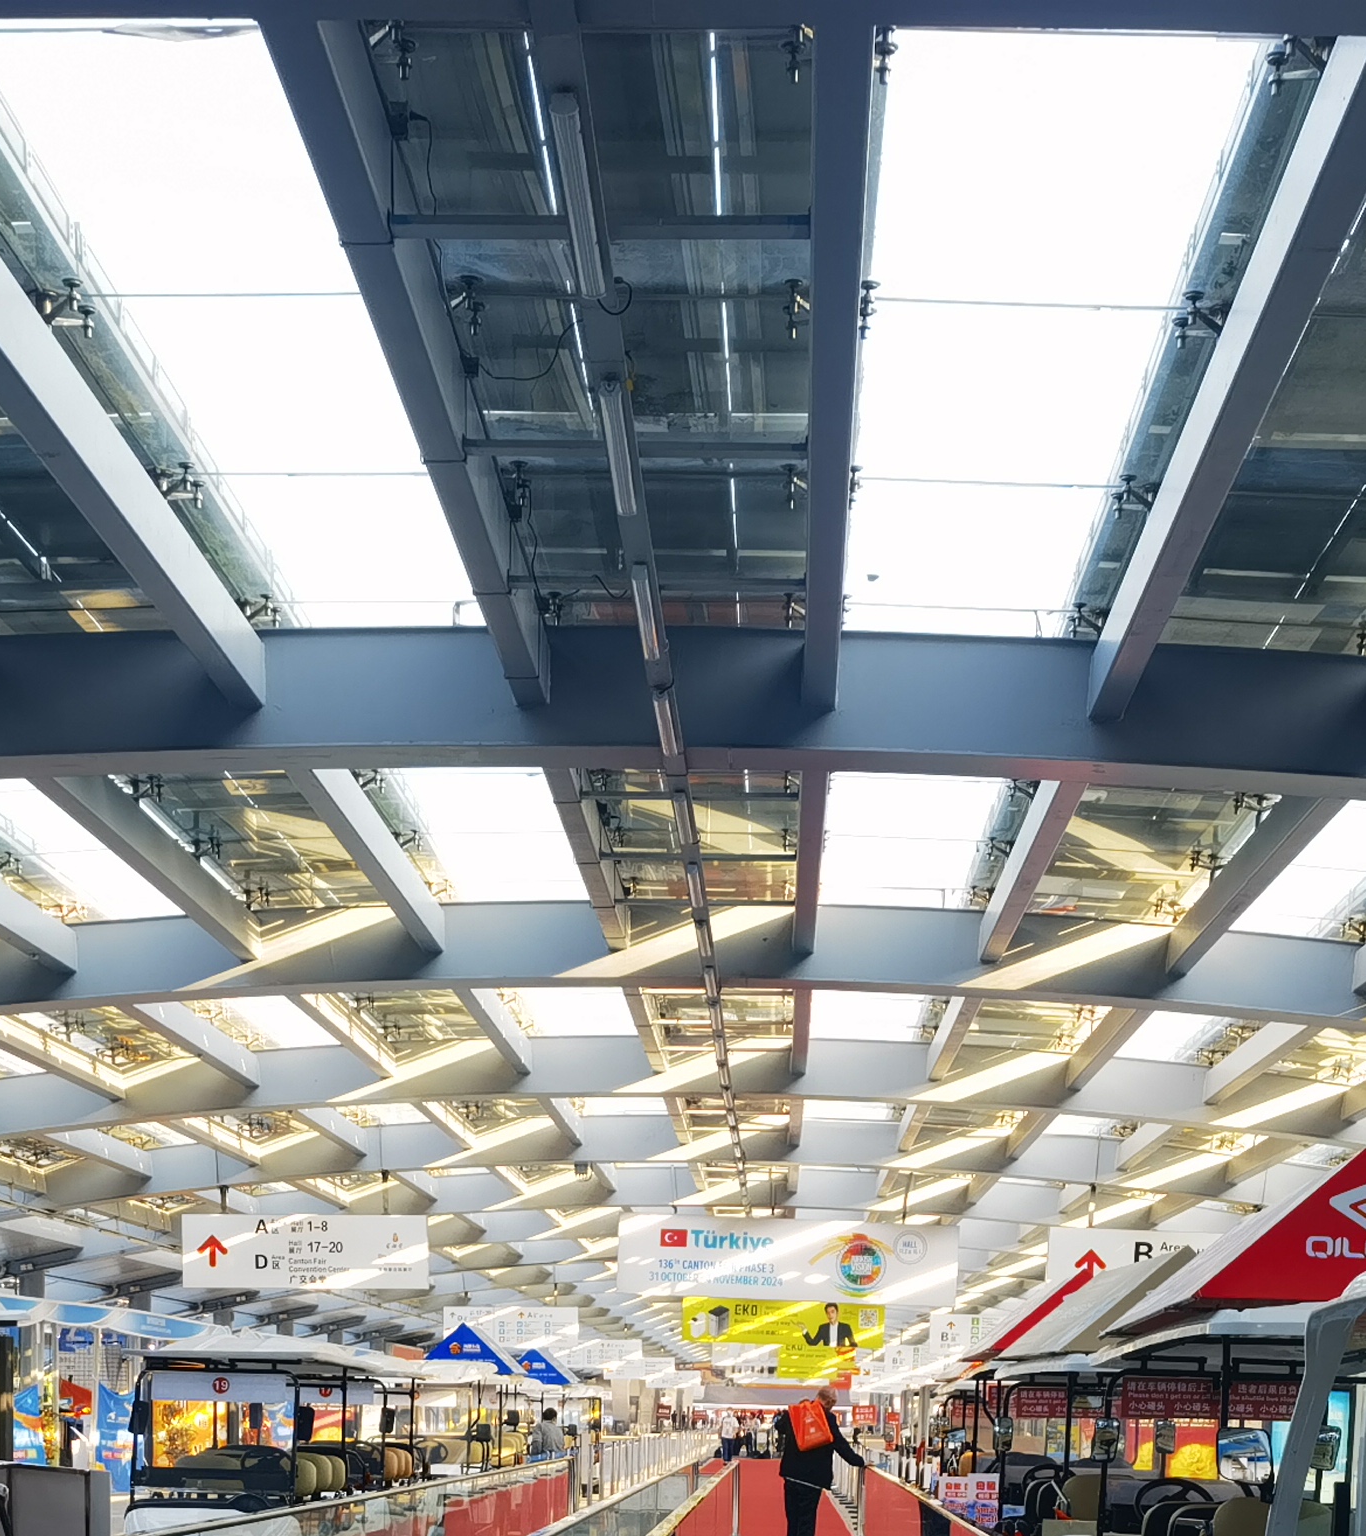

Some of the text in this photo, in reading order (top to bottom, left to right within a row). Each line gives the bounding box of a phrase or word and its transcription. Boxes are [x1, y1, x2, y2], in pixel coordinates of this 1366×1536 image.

[255, 1219, 269, 1235] A
[691, 1229, 774, 1253] Türkiye
[307, 1241, 343, 1254] 17-20
[255, 1254, 268, 1270] D
[272, 1261, 281, 1270] 区
[288, 1257, 327, 1266] Canton Fair
[288, 1265, 327, 1273] Convention
[761, 1276, 783, 1287] 2024
[735, 1304, 757, 1316] EKO
[214, 1379, 229, 1391] 19
[1128, 1401, 1165, 1411] 小心碰头
[1174, 1402, 1211, 1412] 小心碰头
